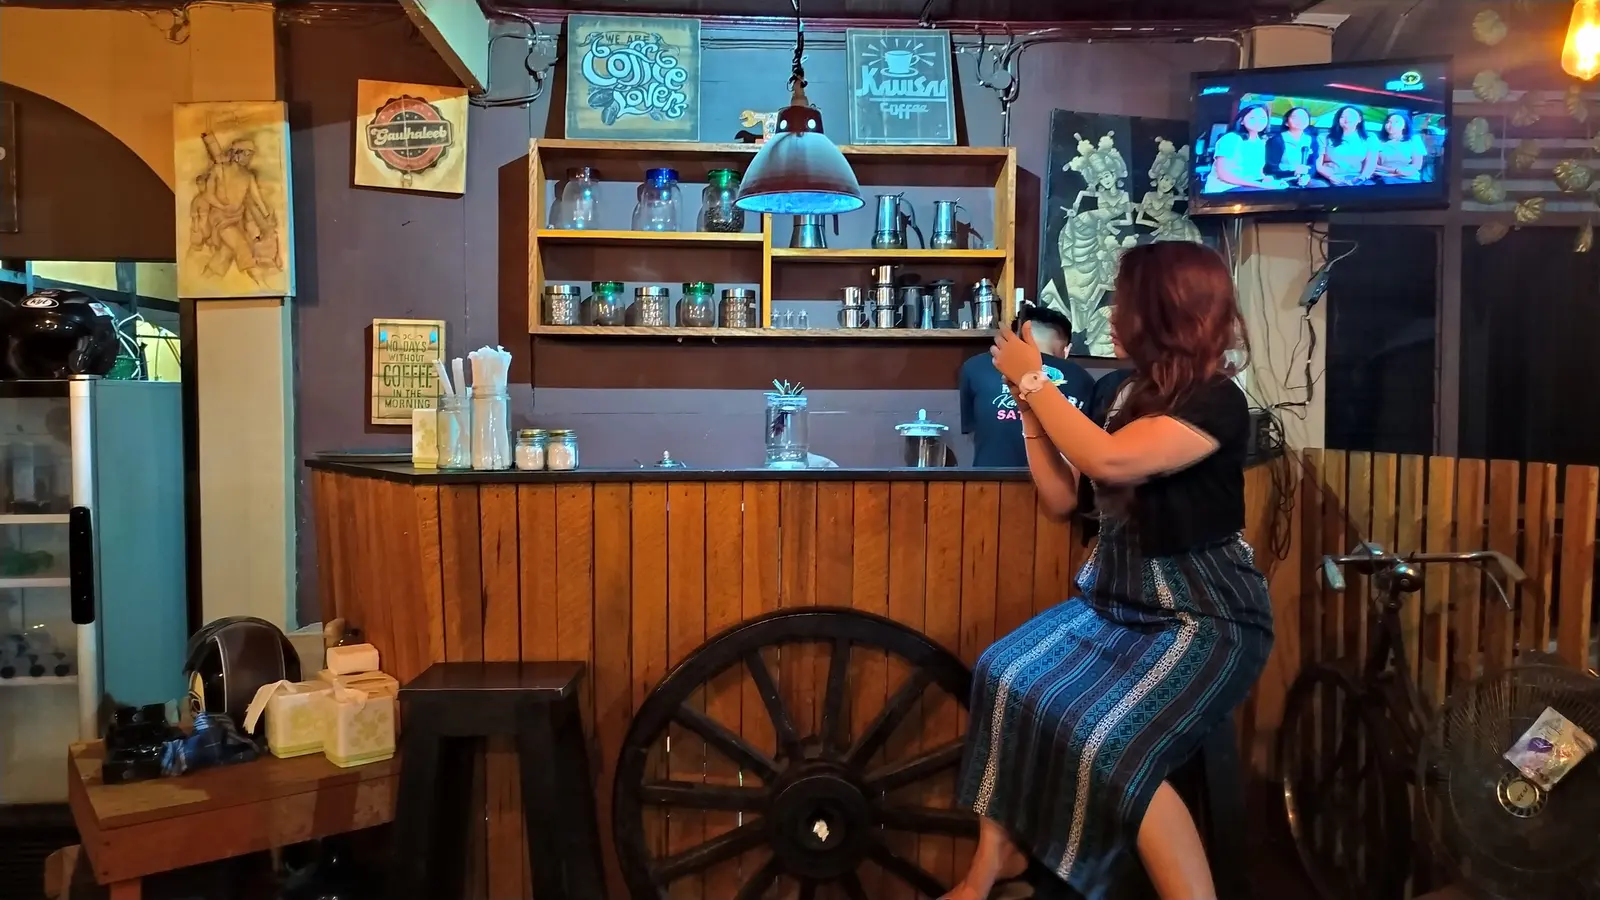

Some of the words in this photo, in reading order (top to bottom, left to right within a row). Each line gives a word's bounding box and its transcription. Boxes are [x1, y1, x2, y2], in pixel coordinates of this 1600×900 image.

[605, 34, 621, 44] WE
[582, 36, 688, 90] Coffee
[612, 82, 688, 119] Lovers
[386, 340, 398, 353] NO
[403, 340, 427, 353] DAYS
[388, 353, 425, 363] WITHOUT
[383, 364, 433, 389] COFFEE
[393, 389, 402, 398] IN
[405, 389, 422, 398] THE
[385, 399, 431, 409] MORNING
